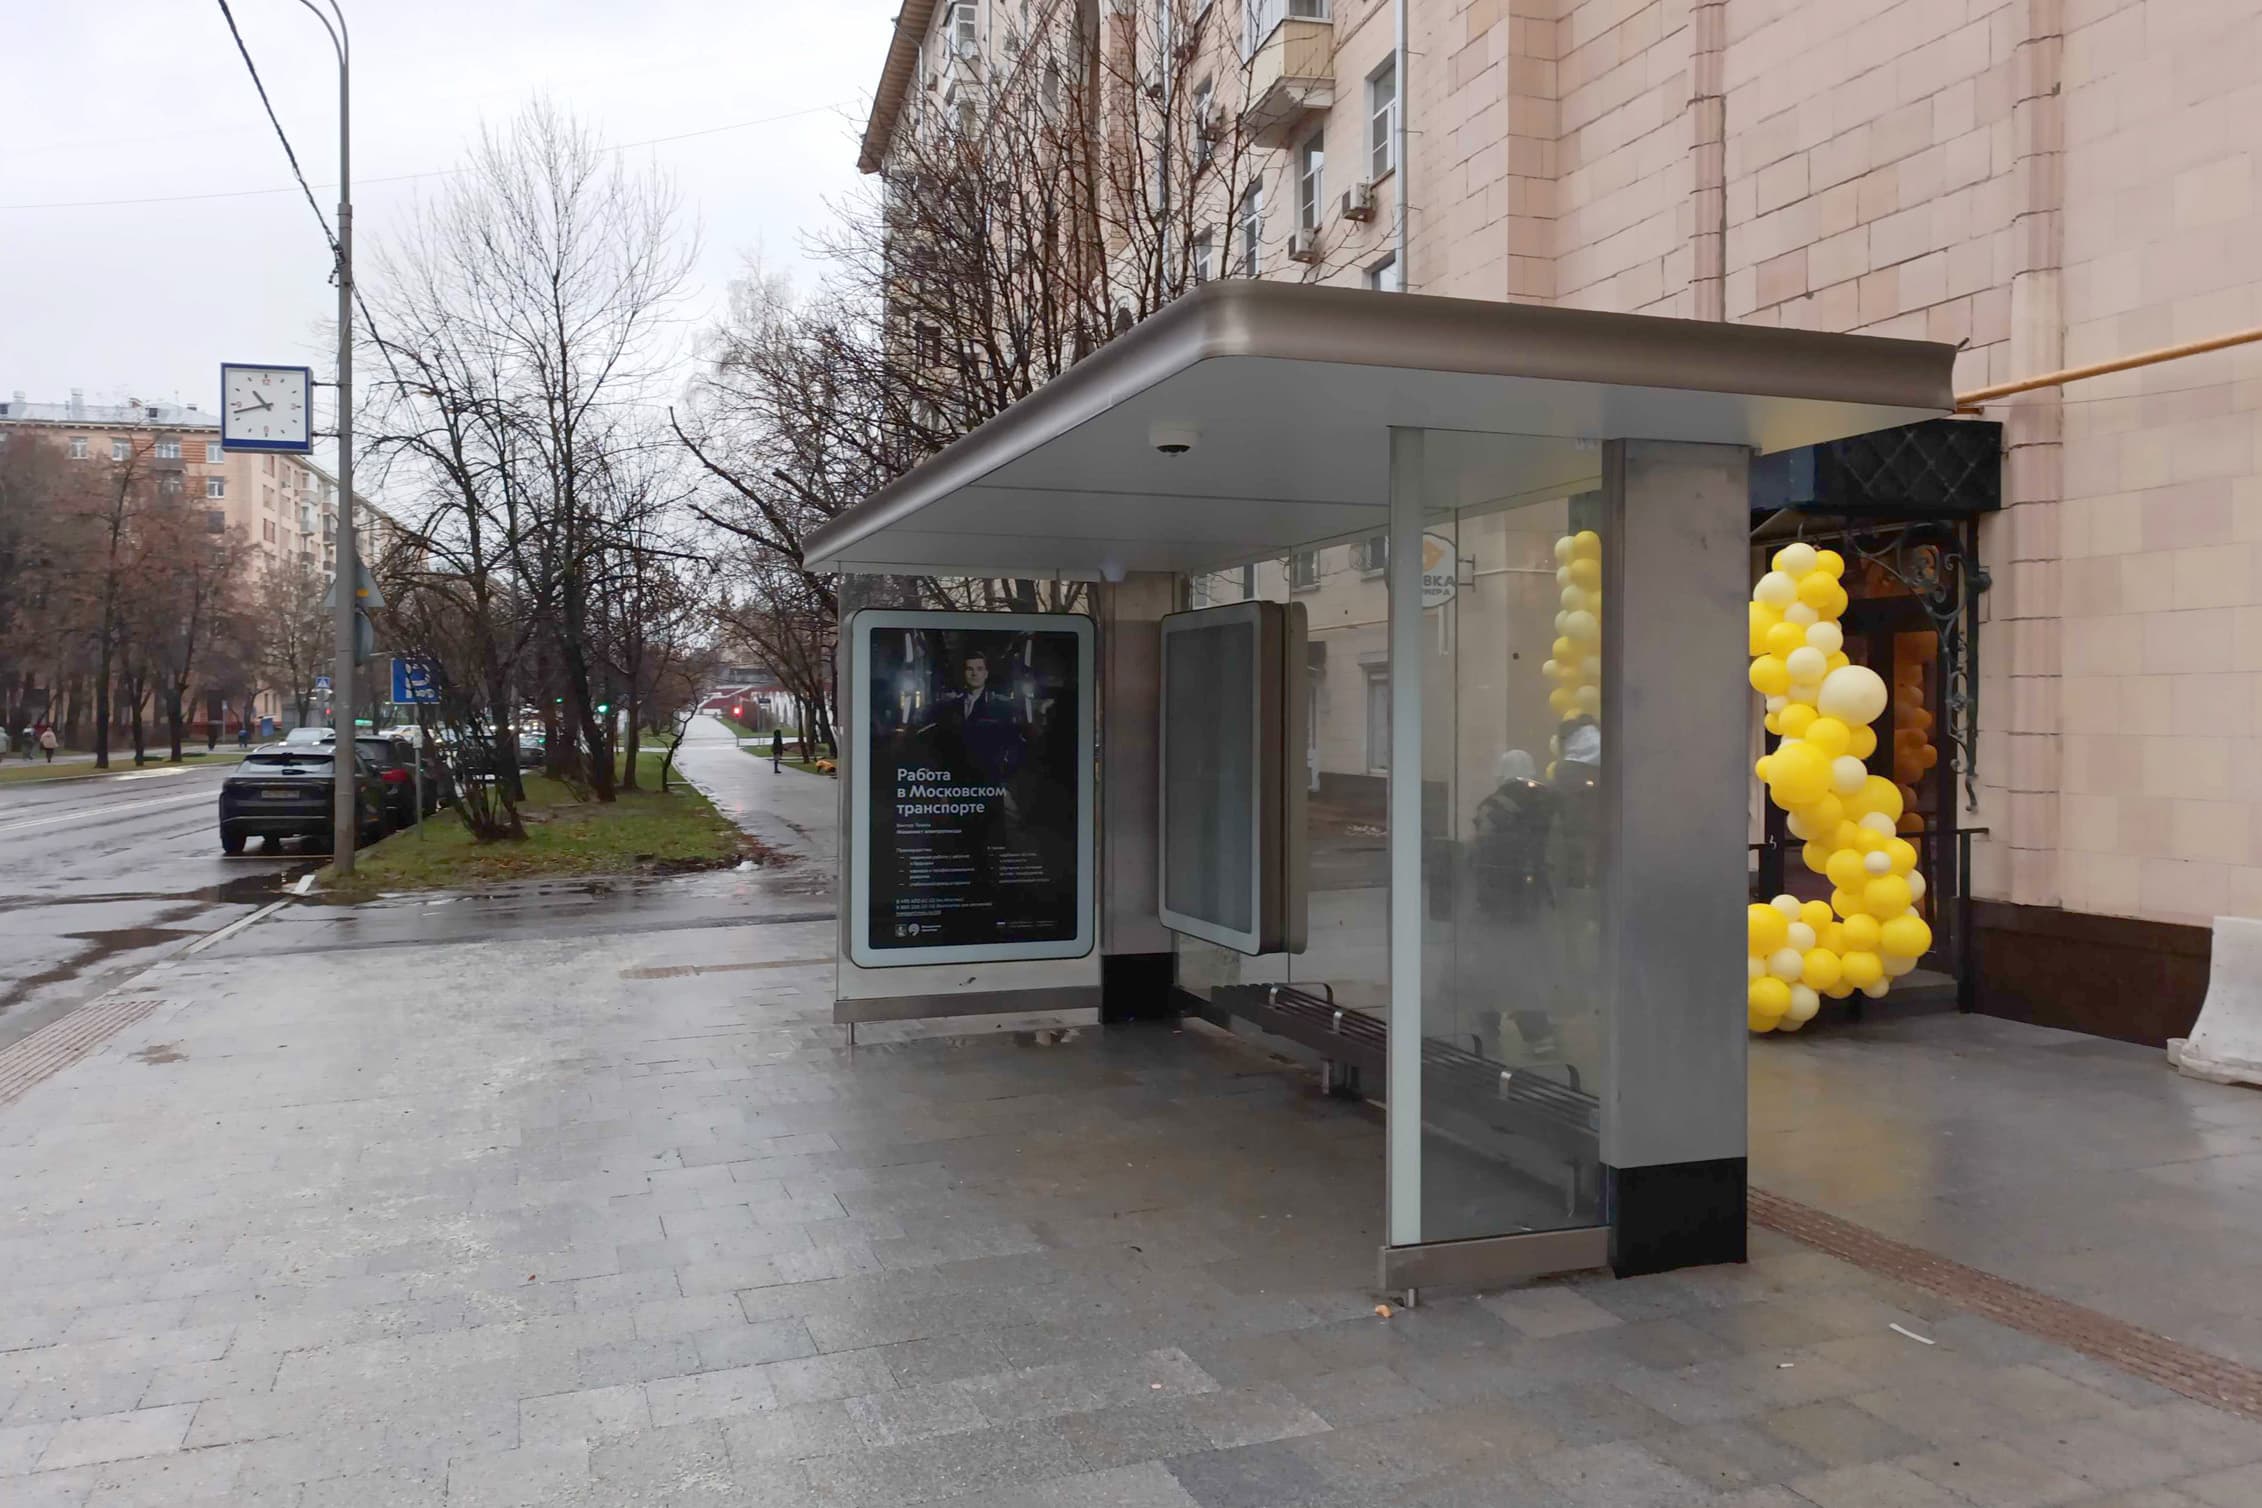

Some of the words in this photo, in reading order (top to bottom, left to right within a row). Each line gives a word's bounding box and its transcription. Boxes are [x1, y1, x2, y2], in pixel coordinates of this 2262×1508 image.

[897, 768, 951, 781] Работа
[897, 788, 906, 798] в
[909, 785, 1007, 798] Московском
[896, 803, 985, 816] транспорте
